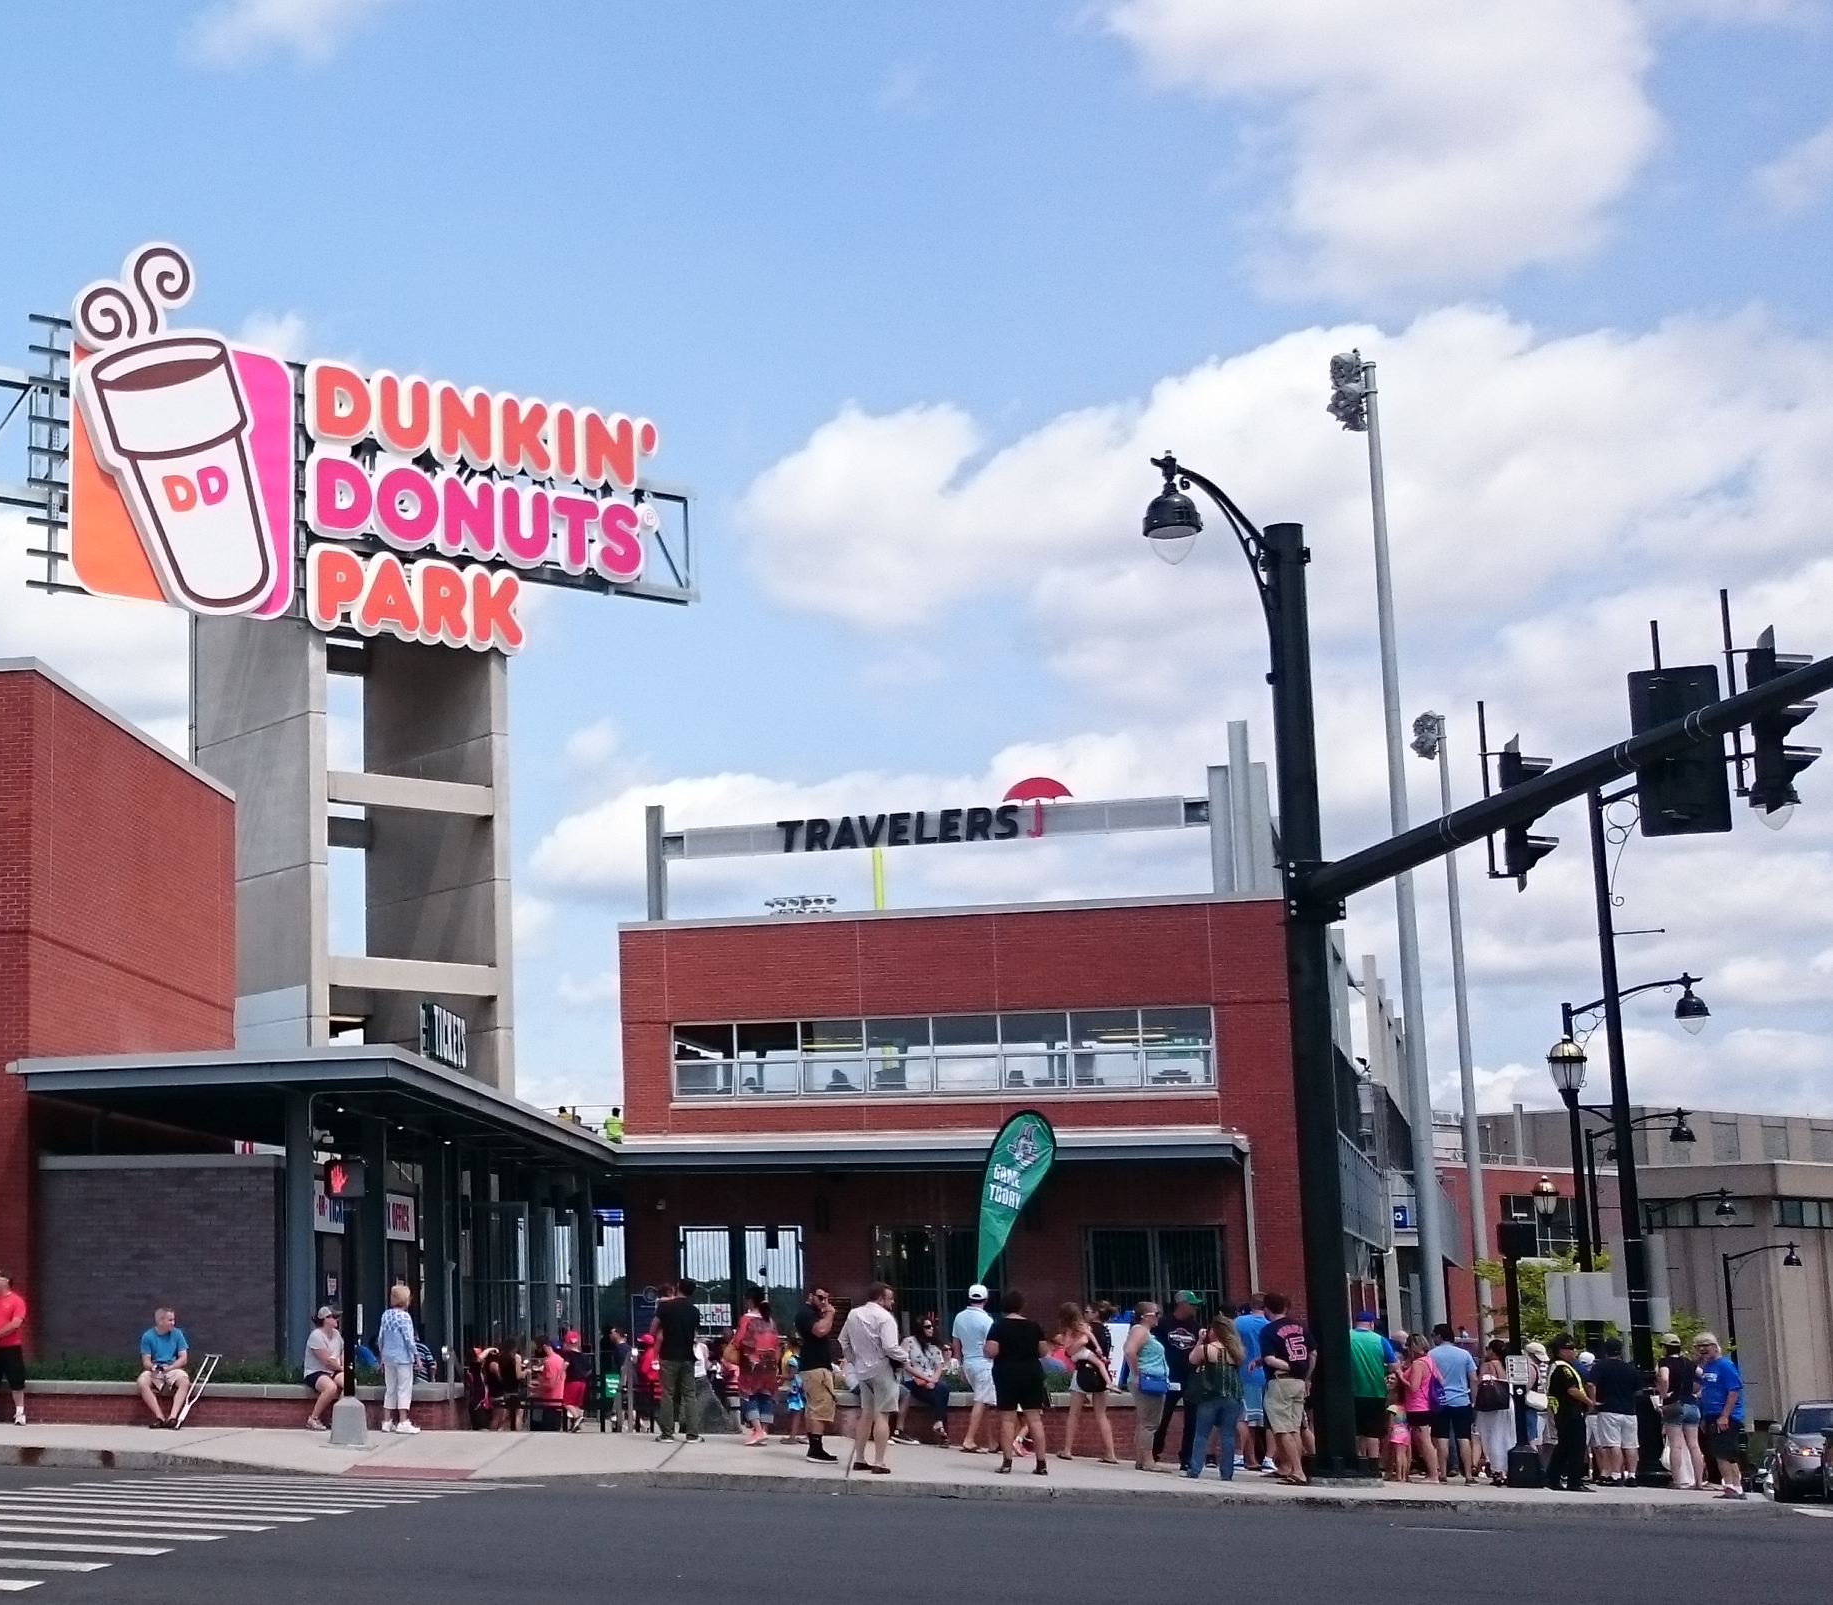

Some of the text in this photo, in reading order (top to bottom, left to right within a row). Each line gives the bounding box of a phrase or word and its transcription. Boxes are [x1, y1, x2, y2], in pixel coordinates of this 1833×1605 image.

[310, 362, 657, 489] DUNKIN'
[161, 465, 229, 513] DD
[310, 455, 644, 578] DONUTS
[310, 547, 525, 650] PARK
[777, 804, 1020, 853] TRAVELERS
[433, 1004, 467, 1069] TICKETS
[989, 1183, 1022, 1210] TODAY
[1284, 1336, 1307, 1361] 15
